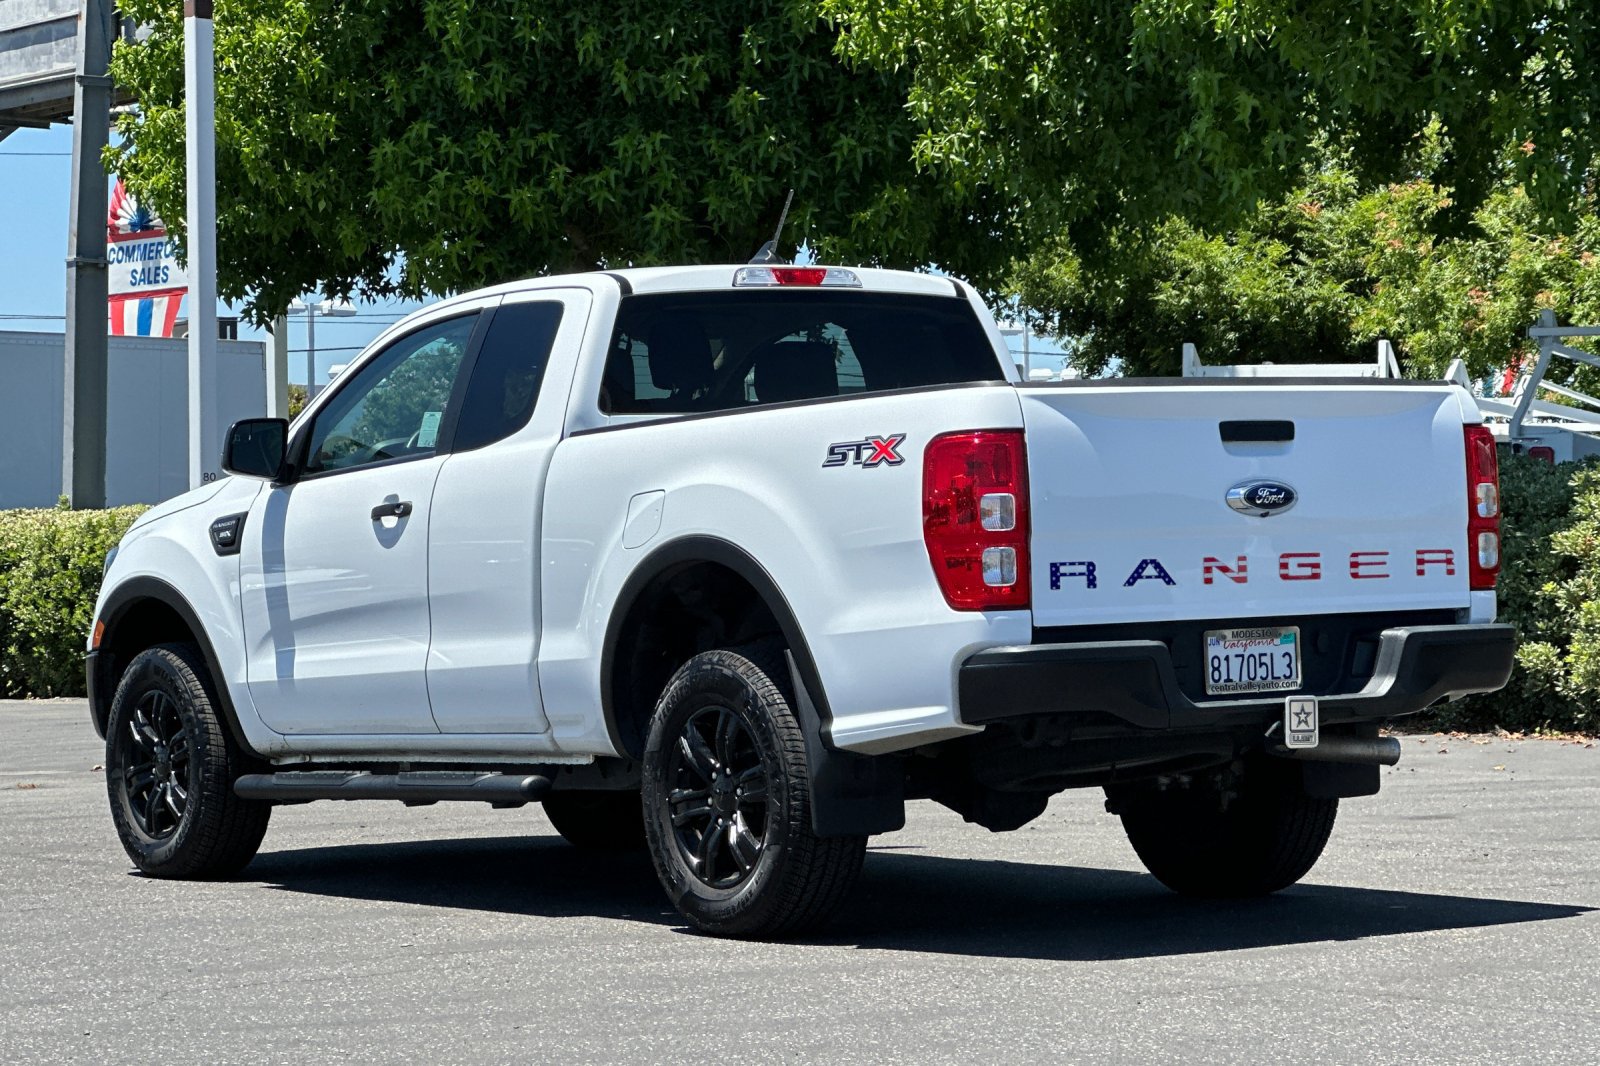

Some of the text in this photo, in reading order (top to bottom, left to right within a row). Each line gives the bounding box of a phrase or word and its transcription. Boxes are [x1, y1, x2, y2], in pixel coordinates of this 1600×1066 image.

[108, 241, 176, 265] COMMERC
[130, 265, 170, 287] SALES
[821, 432, 907, 469] STX
[203, 472, 217, 482] 80
[1255, 487, 1286, 504] Ford
[1049, 549, 1456, 591] RANGER
[1231, 630, 1272, 639] MODESTO
[1223, 638, 1281, 652] California
[1210, 651, 1293, 684] 81705L3
[1210, 680, 1298, 693] centralvalleyauto.com
